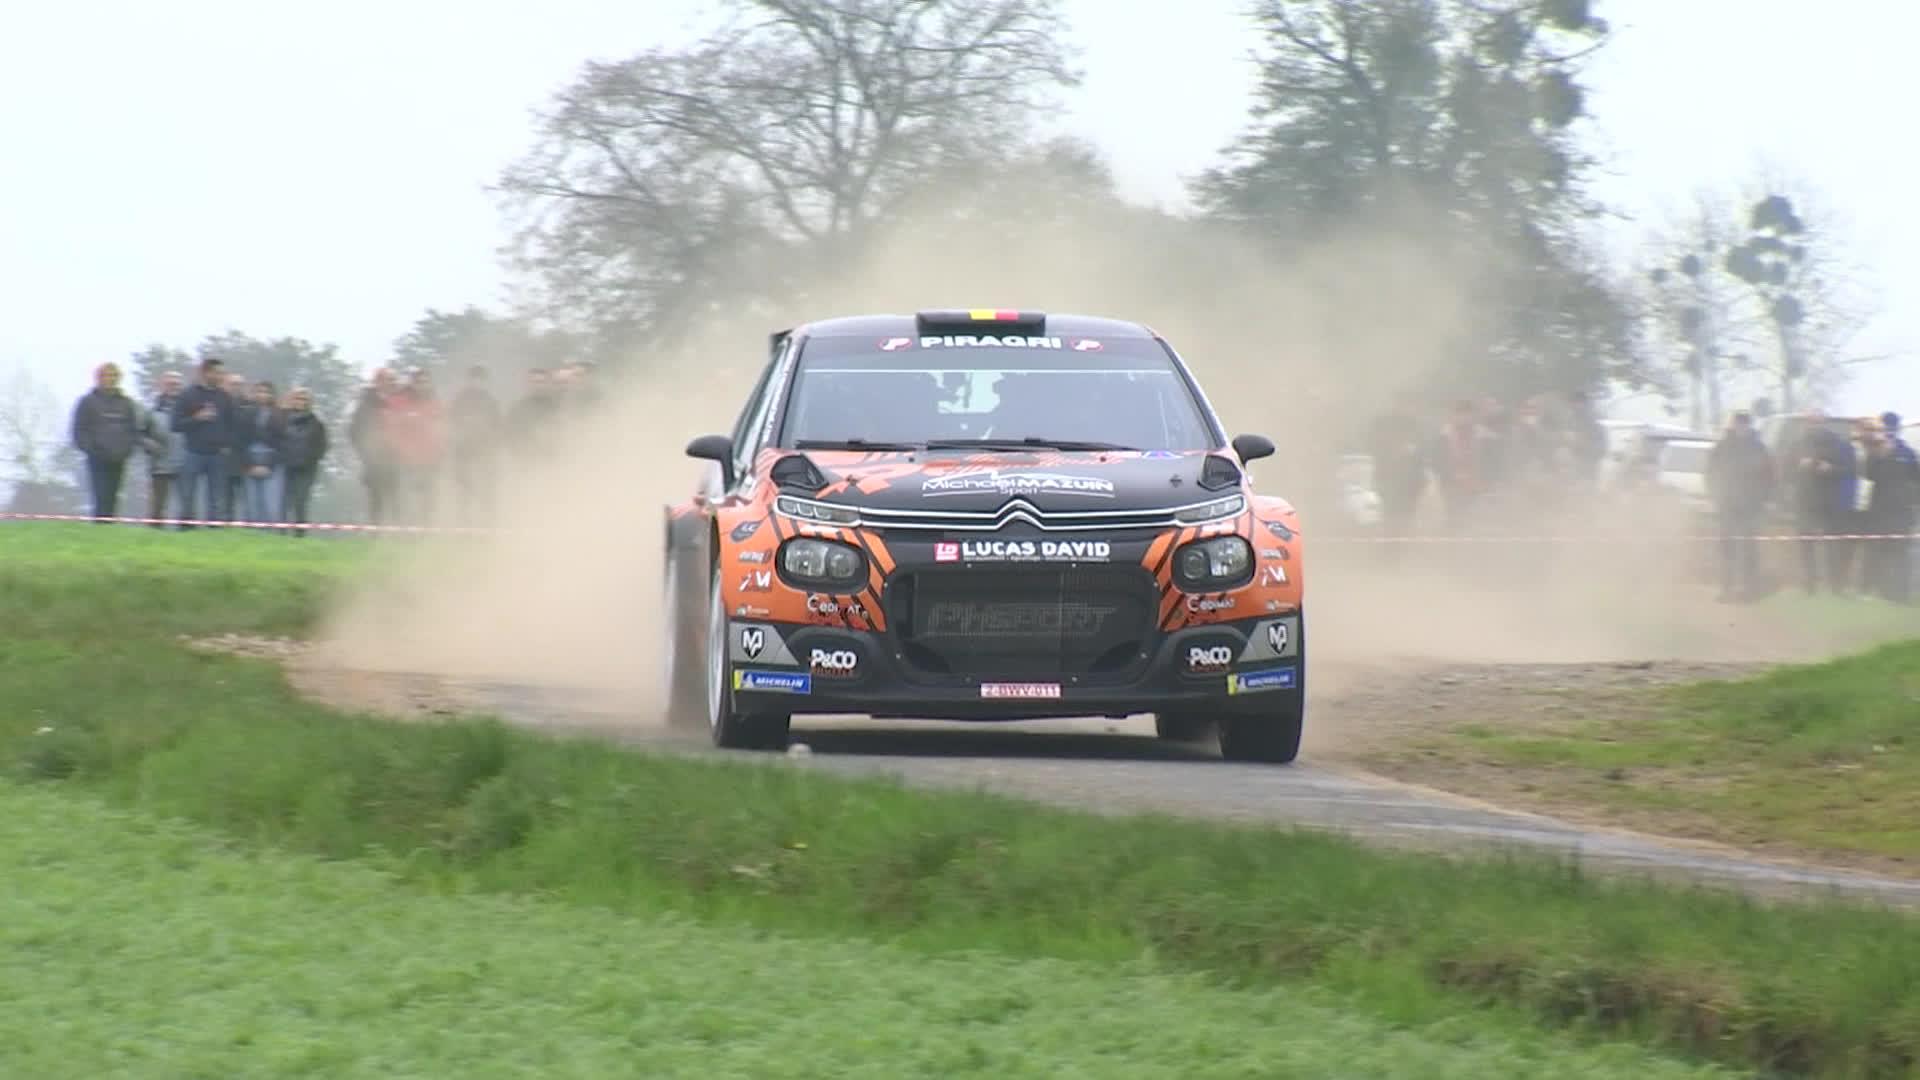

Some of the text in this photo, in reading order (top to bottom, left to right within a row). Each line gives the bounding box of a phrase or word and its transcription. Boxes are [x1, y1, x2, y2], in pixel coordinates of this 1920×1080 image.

[921, 336, 1062, 348] PIRAGRI
[1016, 479, 1114, 492] MAZUIN
[962, 541, 1036, 556] LUCAS
[1042, 541, 1110, 556] DAVID
[810, 649, 857, 669] P&CO
[1189, 647, 1232, 666] P&CO
[755, 677, 804, 688] MICHELIN
